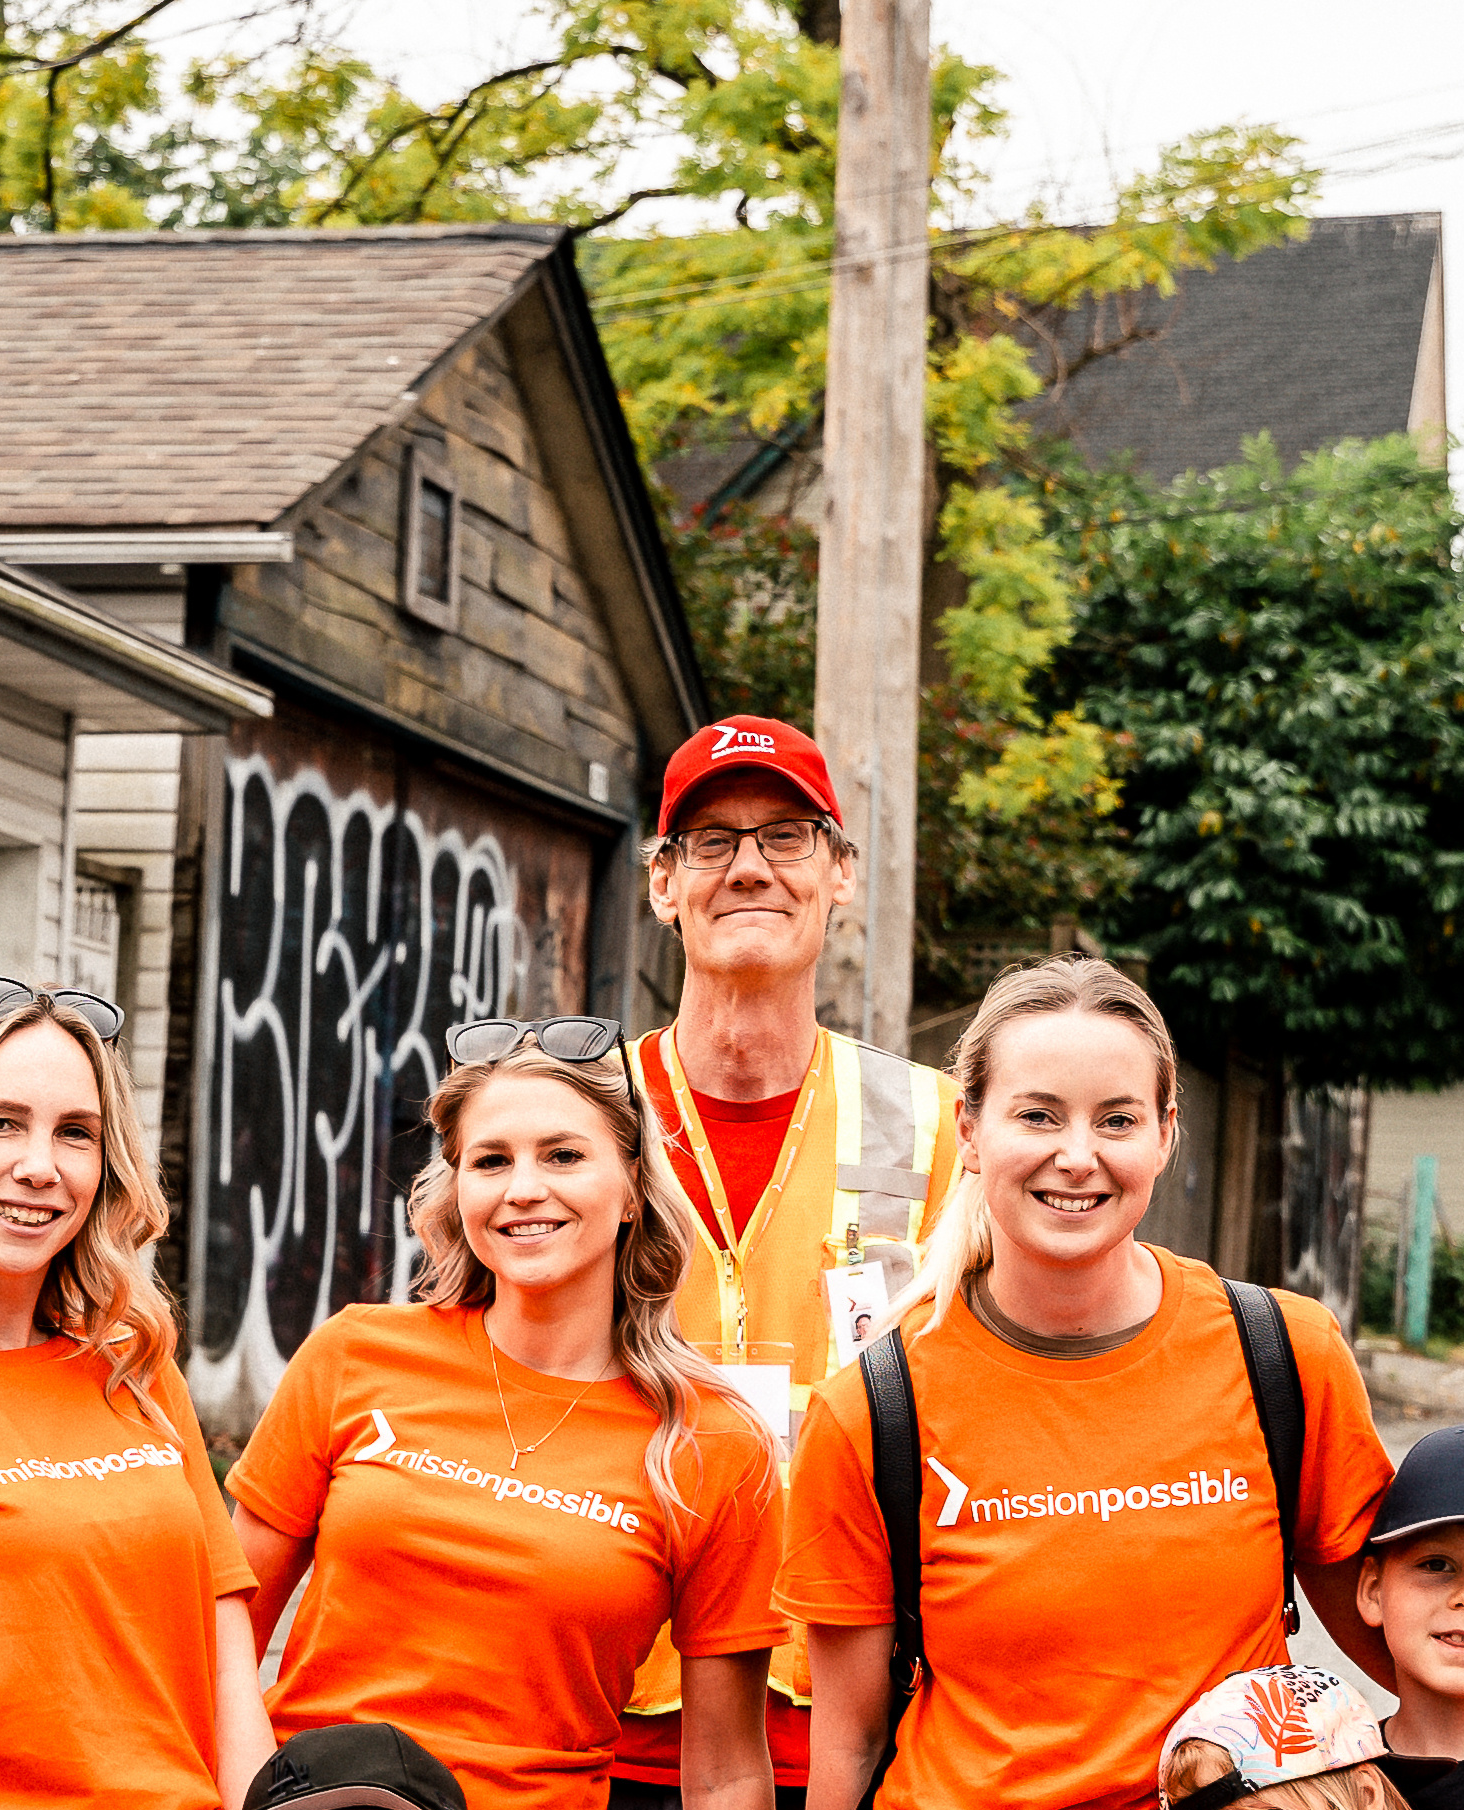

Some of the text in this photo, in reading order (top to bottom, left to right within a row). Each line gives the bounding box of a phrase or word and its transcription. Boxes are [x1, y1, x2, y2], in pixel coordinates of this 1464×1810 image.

[737, 731, 774, 747] mp
[385, 1448, 640, 1534] missionpossible
[970, 1468, 1249, 1523] missionpossible
